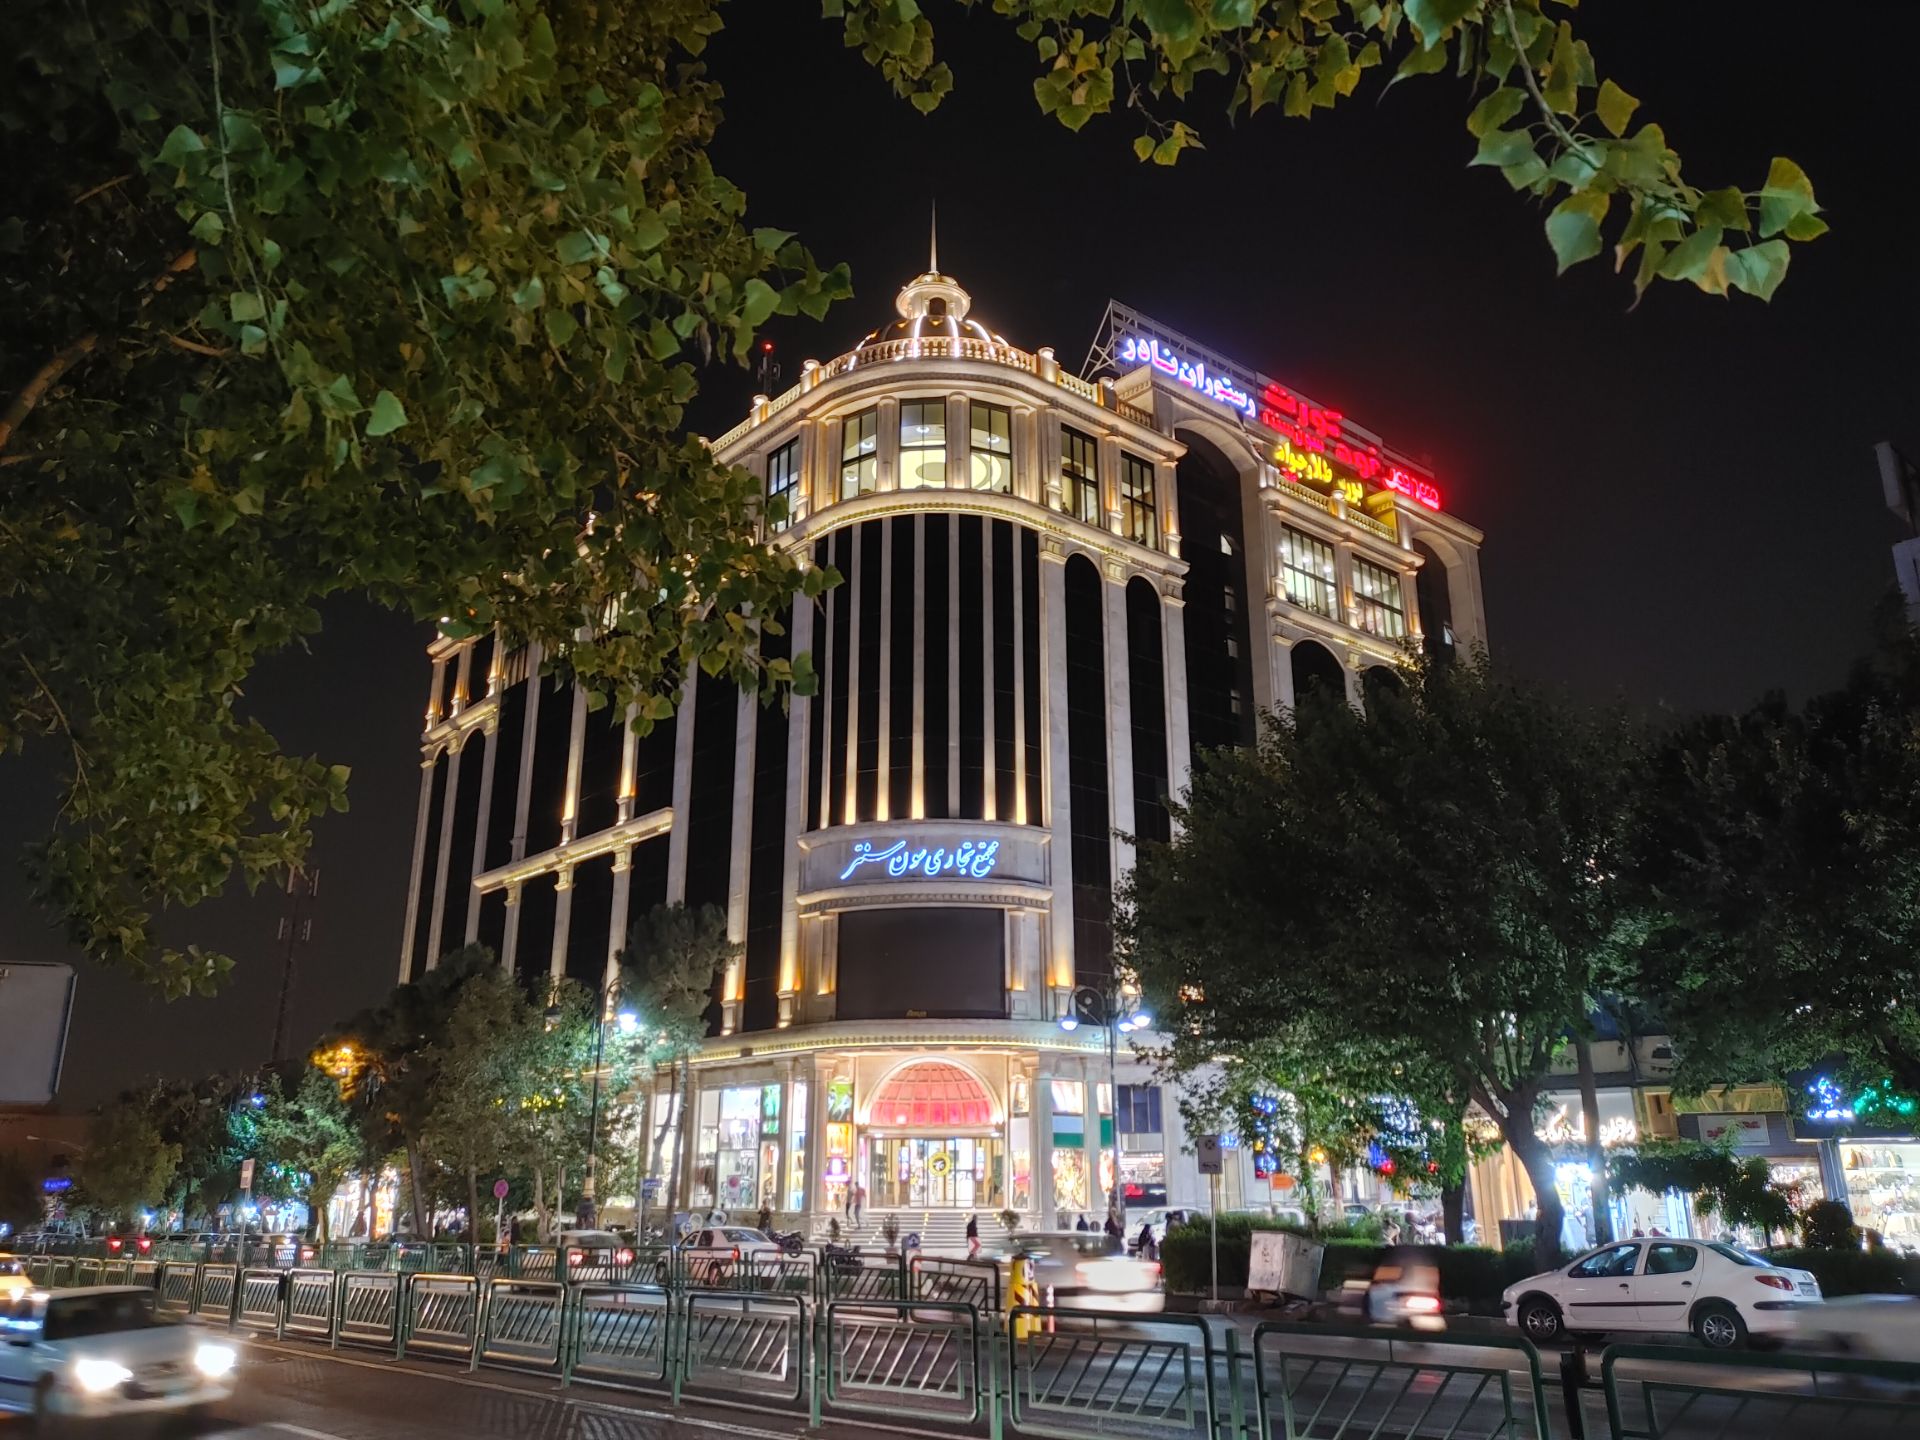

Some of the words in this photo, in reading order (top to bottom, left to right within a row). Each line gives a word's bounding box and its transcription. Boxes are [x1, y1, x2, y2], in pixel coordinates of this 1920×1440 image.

[1121, 337, 1179, 377] نادر
[1178, 361, 1257, 418] رستوران
[840, 839, 907, 880] سنتر
[924, 841, 976, 877] تجاری
